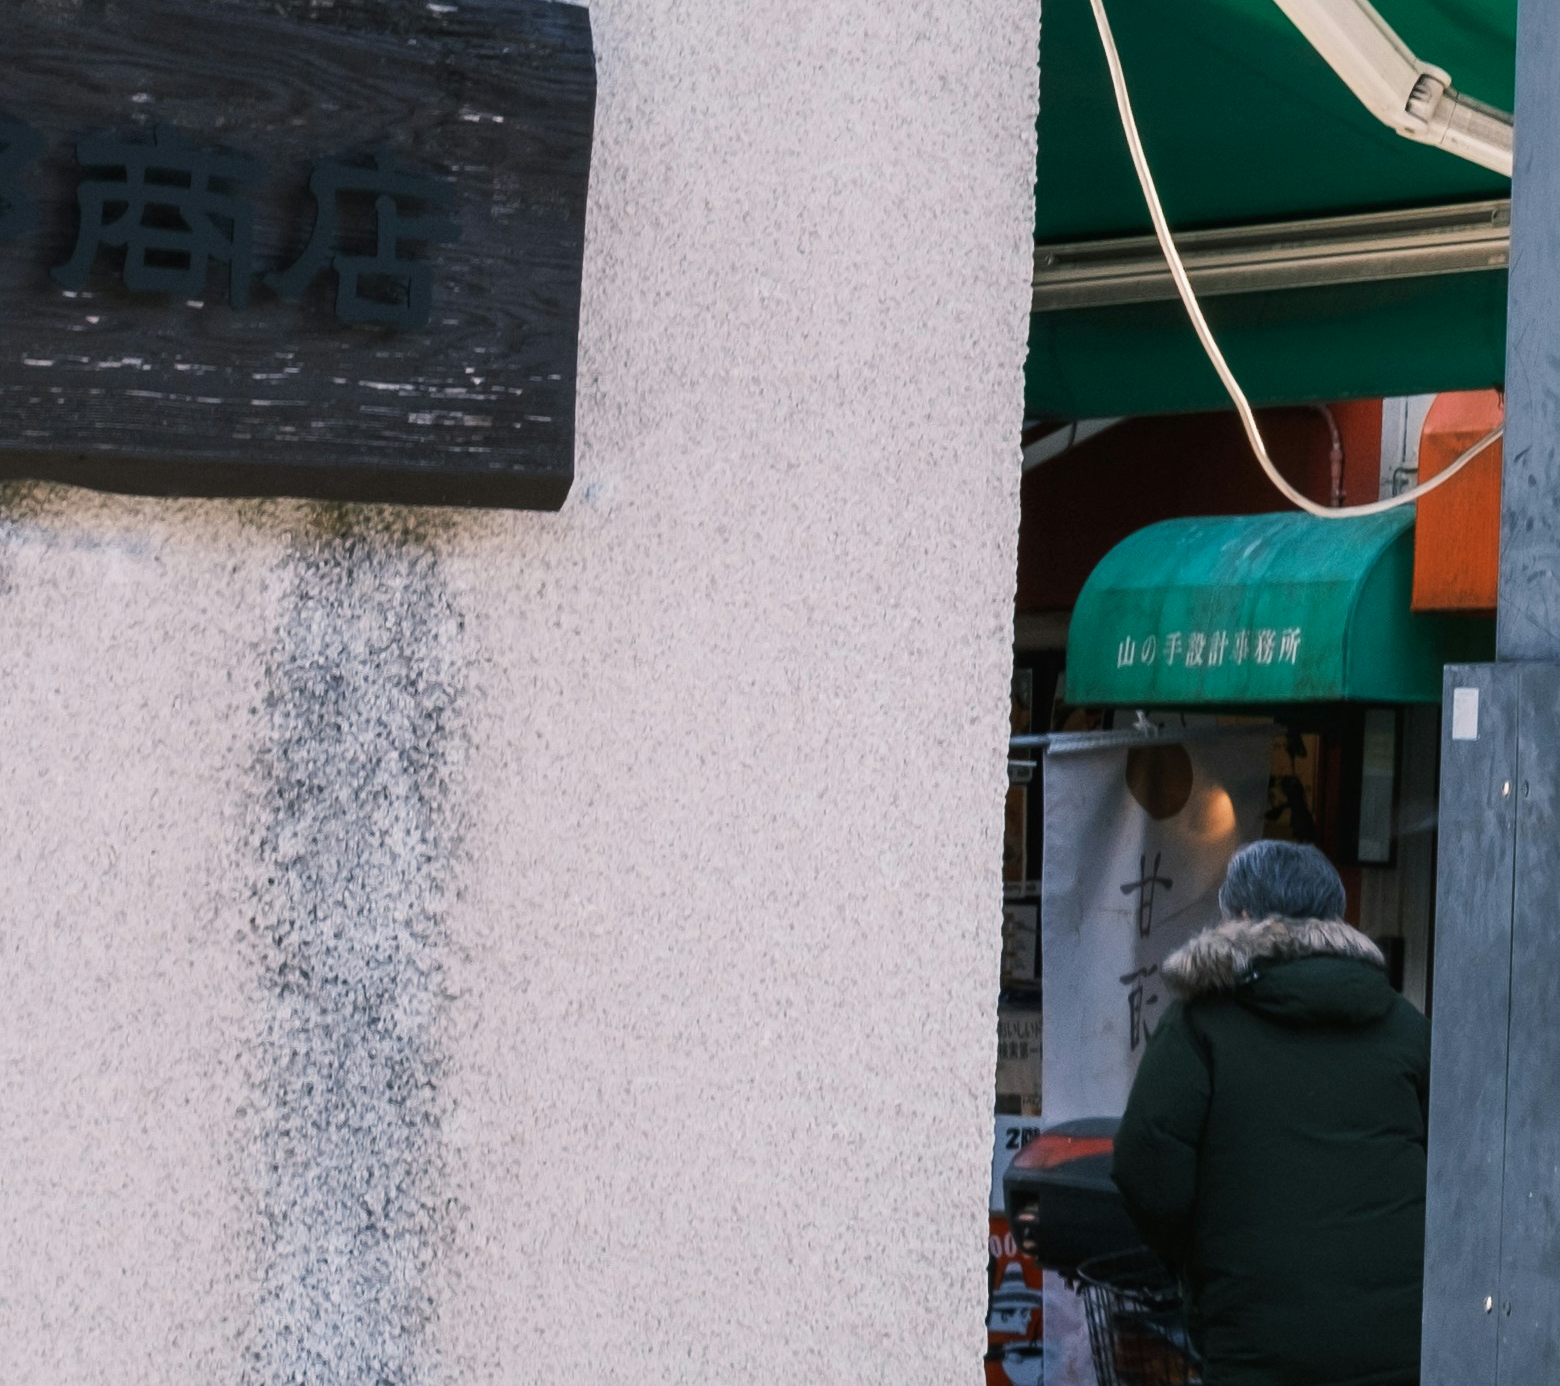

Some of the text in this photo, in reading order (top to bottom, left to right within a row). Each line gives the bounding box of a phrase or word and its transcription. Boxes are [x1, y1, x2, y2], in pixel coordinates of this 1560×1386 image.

[0, 112, 463, 330] 商店
[1117, 627, 1300, 669] 山の手設計事務所
